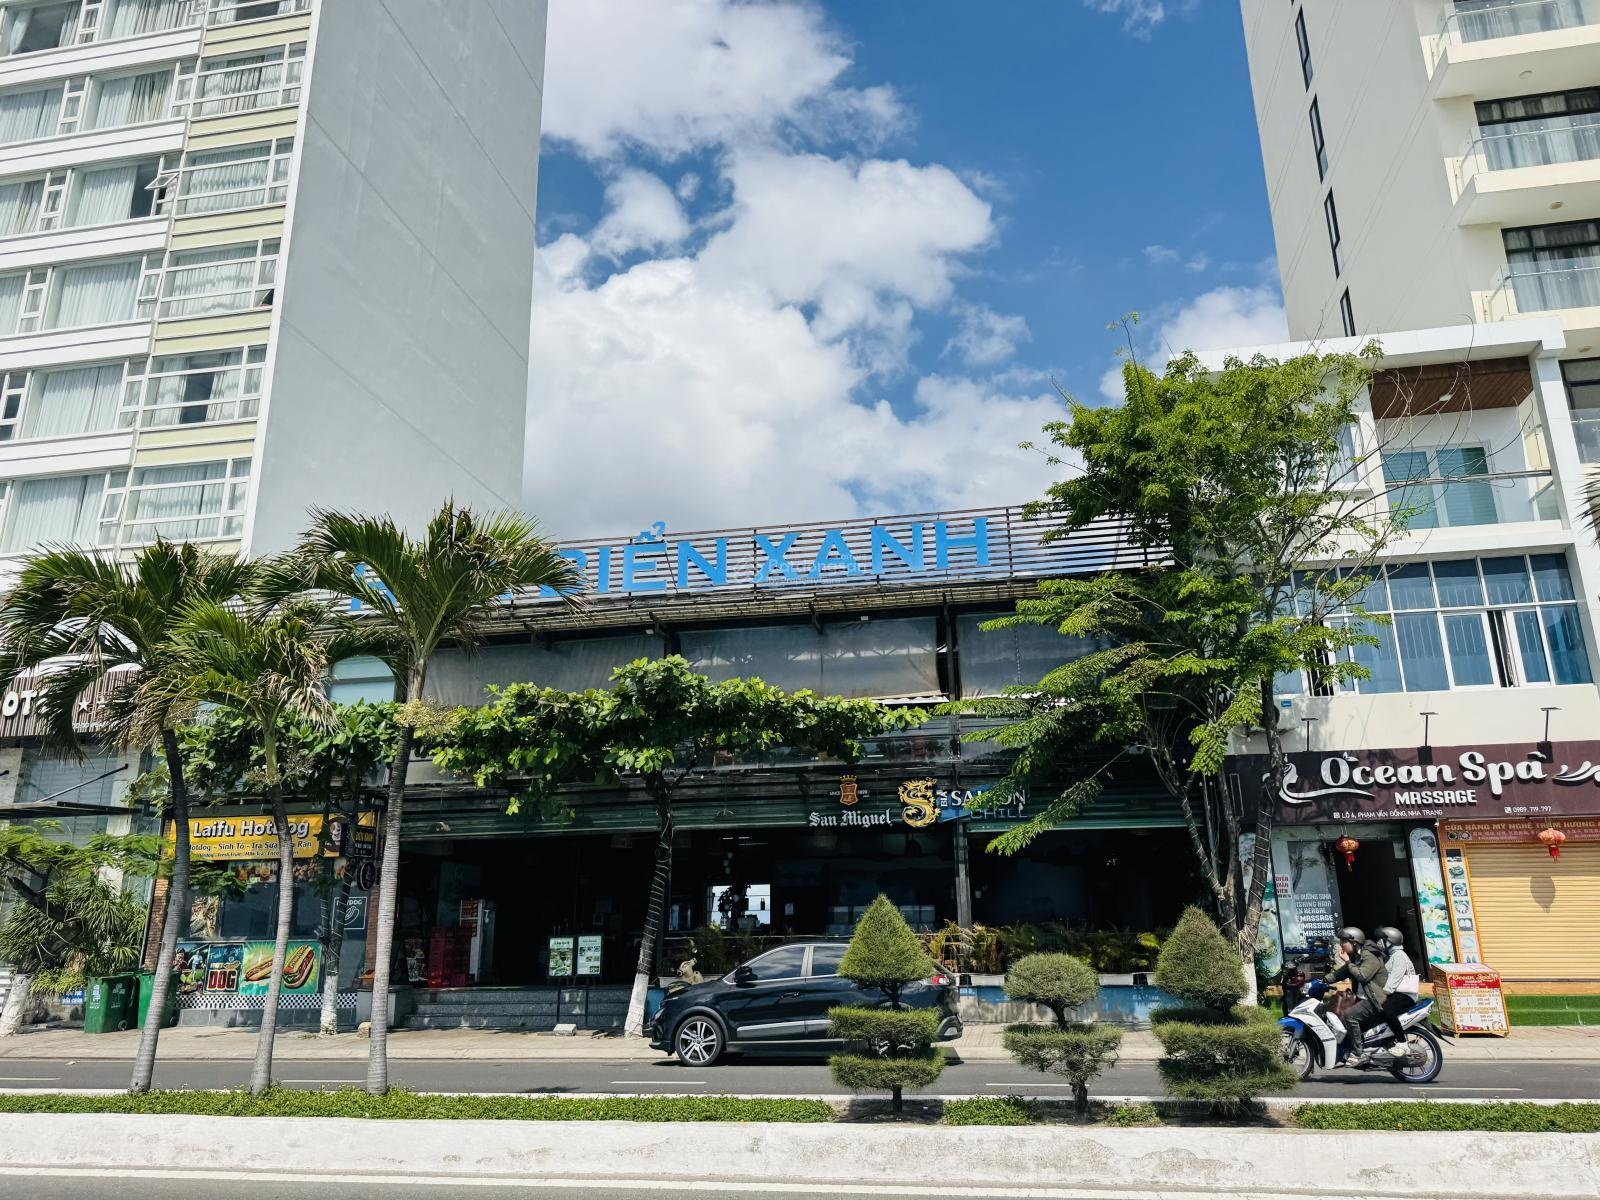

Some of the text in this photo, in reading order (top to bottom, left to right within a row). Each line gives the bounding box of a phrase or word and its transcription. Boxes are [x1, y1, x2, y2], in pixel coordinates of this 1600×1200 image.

[752, 517, 991, 583] XANH
[1320, 751, 1548, 796] Ocean Spa
[940, 789, 1026, 807] BIA SAON
[1394, 789, 1478, 806] MASSAGE
[808, 808, 893, 829] San Miguel
[970, 808, 1028, 819] CHILL
[193, 818, 310, 839] Laifu Hotog
[218, 842, 234, 850] Sinh
[207, 969, 238, 990] DOG
